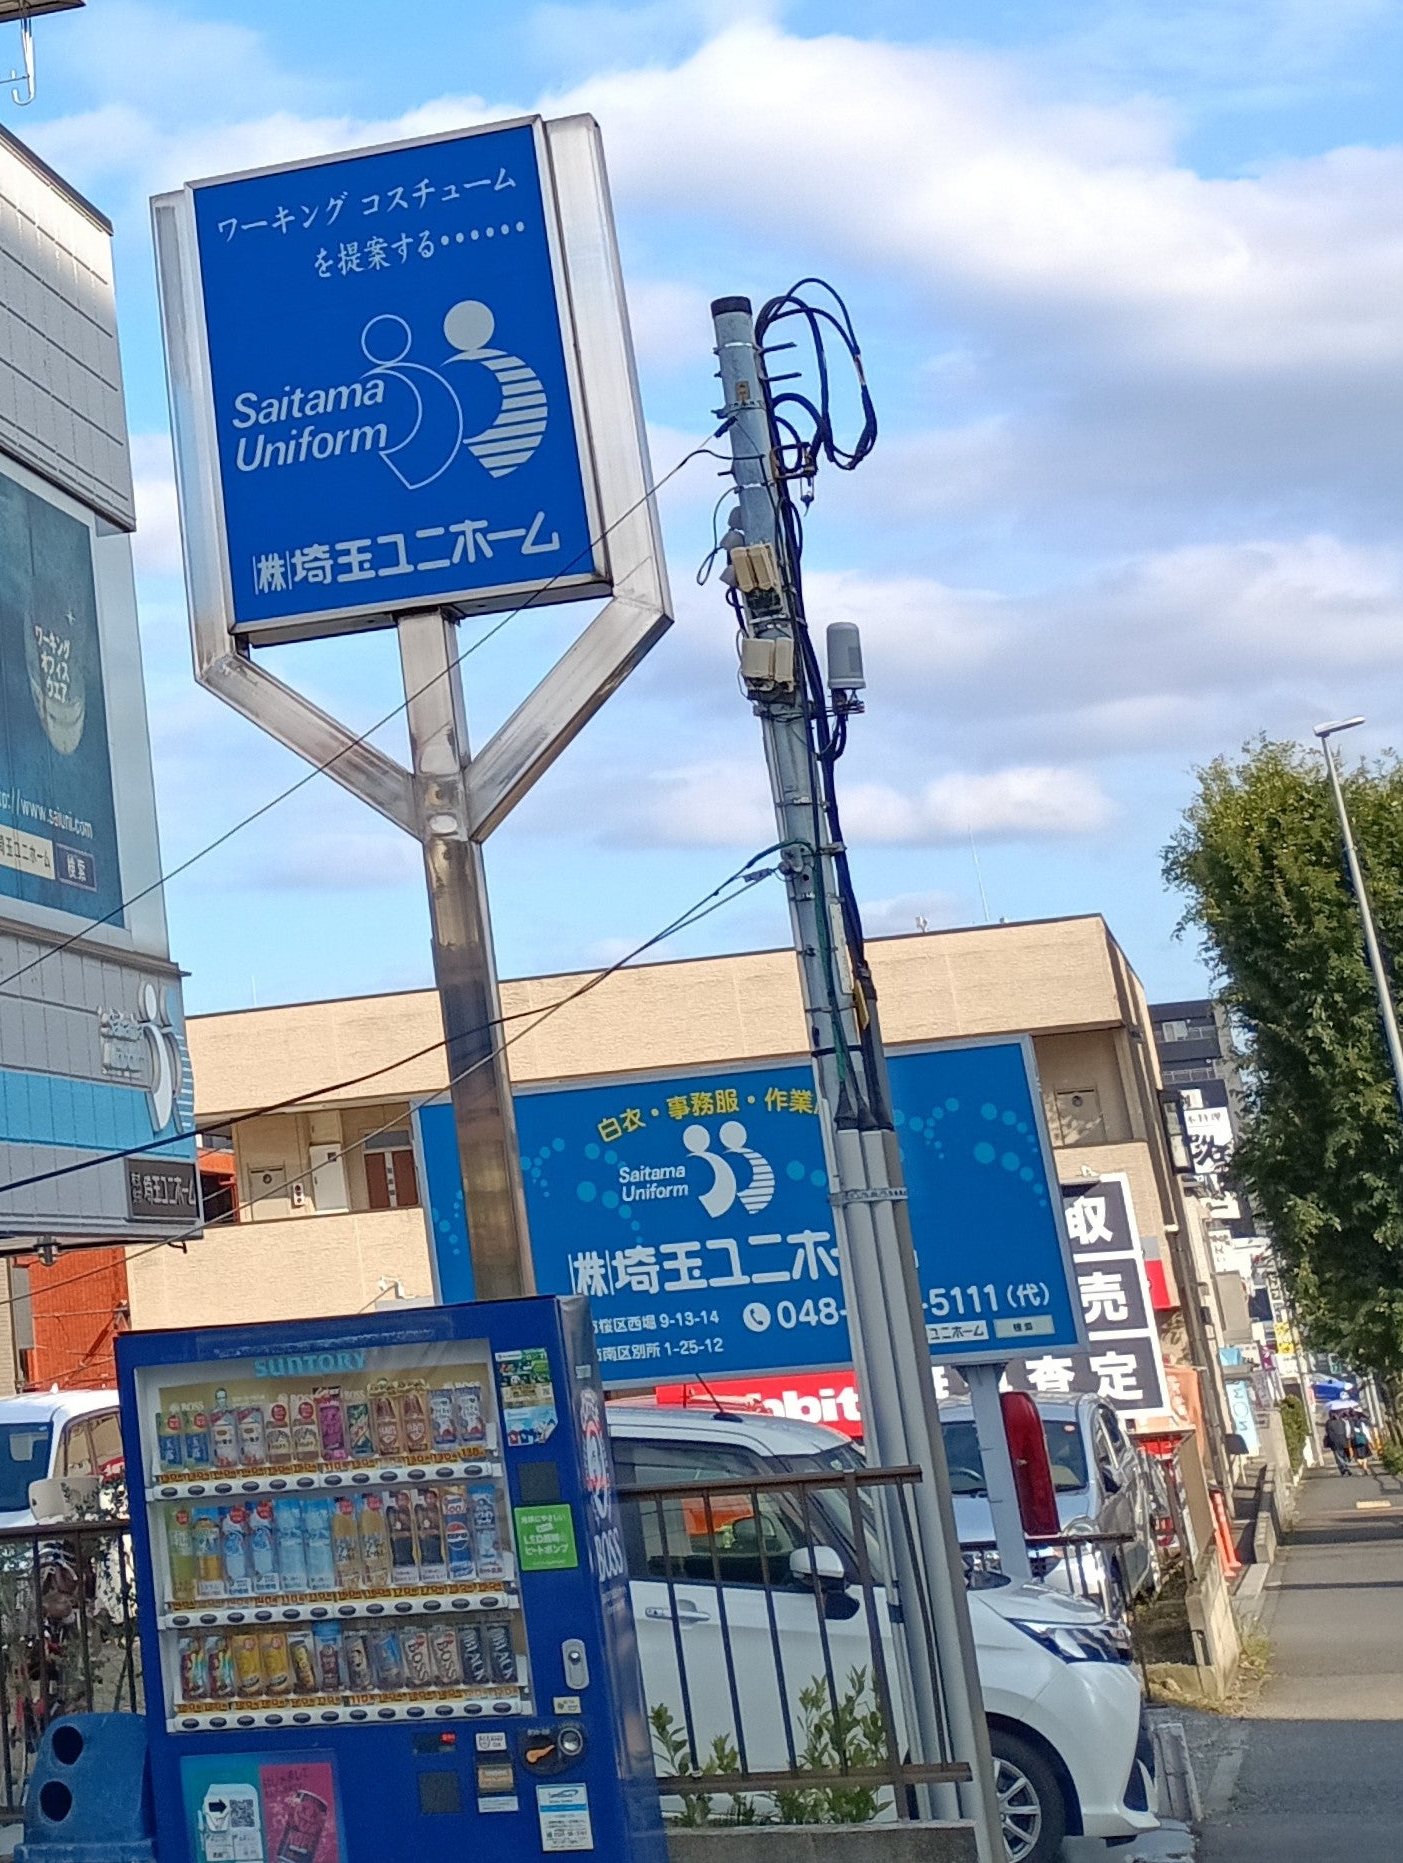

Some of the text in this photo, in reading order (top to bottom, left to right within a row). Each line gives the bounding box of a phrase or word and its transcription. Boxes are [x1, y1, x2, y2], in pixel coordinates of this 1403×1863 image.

[217, 167, 517, 242] ワーキング コスチューム
[231, 375, 386, 429] Saitama
[236, 422, 388, 472] Uniform
[597, 1087, 820, 1143] 白衣・事務服・作業
[618, 1165, 686, 1184] Saitama
[621, 1182, 689, 1202] Uniform
[659, 1310, 720, 1329] 9-13-14
[1077, 1271, 1129, 1324] 売
[664, 1337, 724, 1357] 1-25-12
[594, 1526, 624, 1583] BOSS
[407, 1639, 430, 1683] BOSS
[436, 1639, 458, 1683] BOSS
